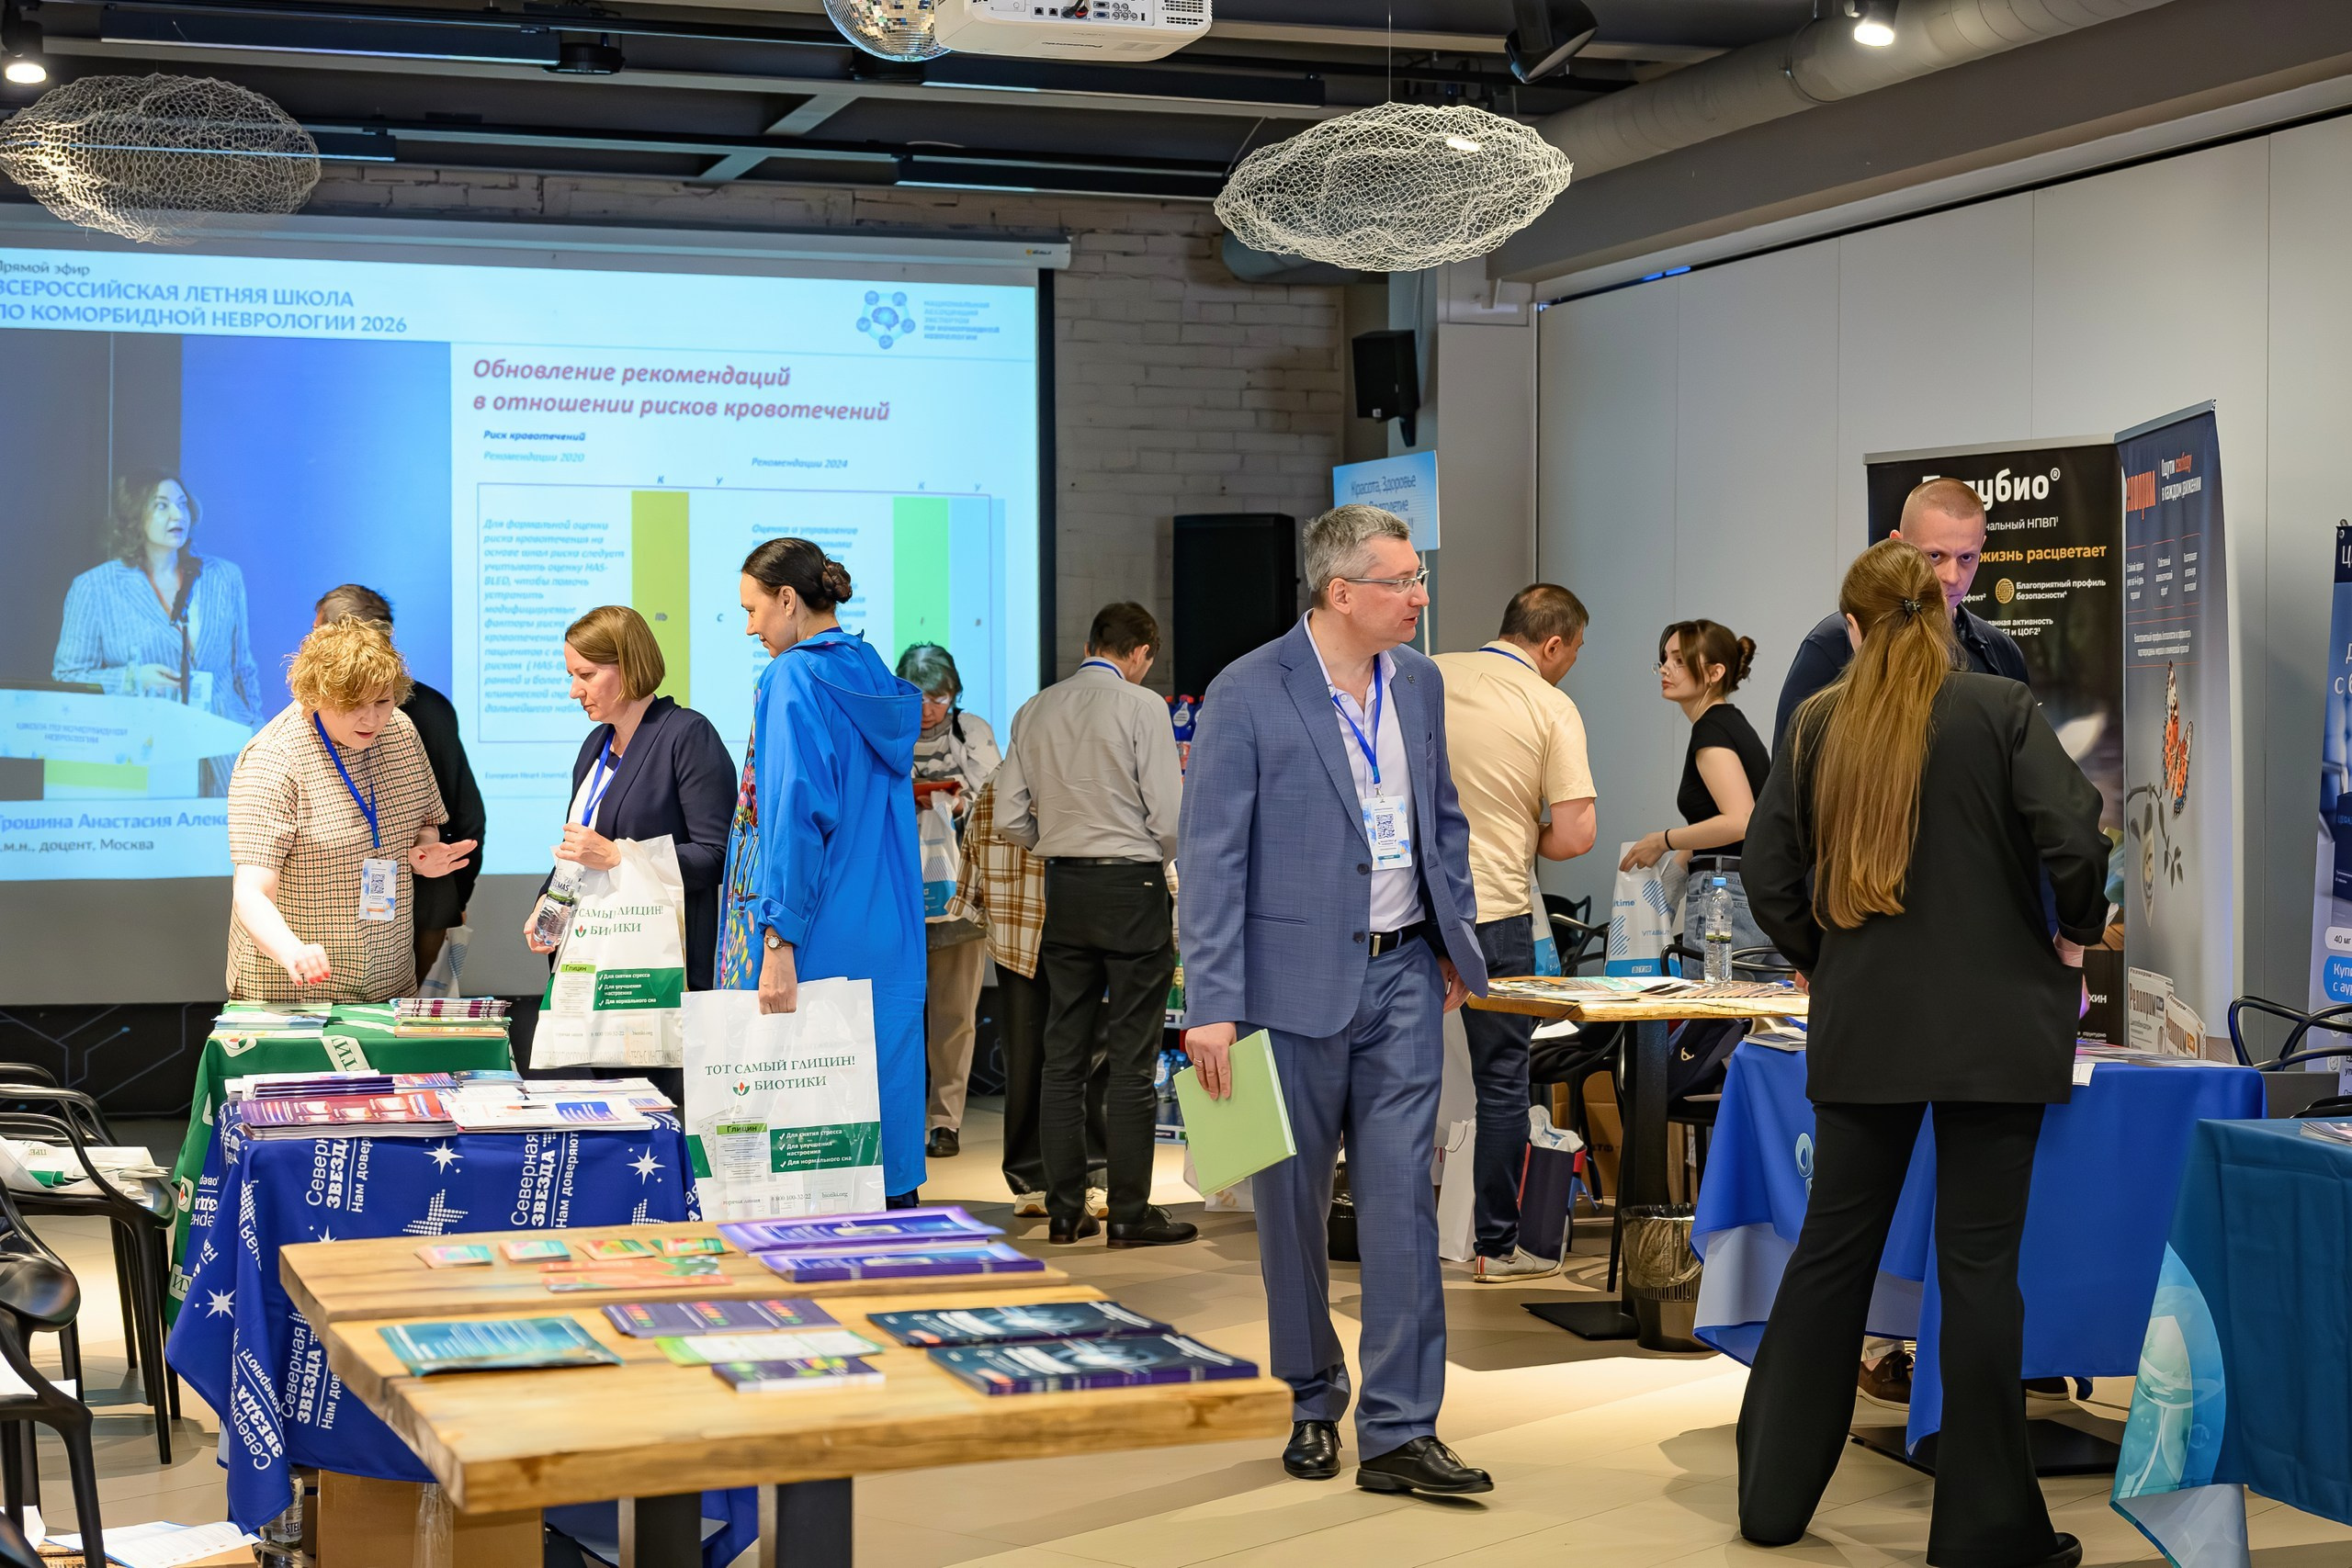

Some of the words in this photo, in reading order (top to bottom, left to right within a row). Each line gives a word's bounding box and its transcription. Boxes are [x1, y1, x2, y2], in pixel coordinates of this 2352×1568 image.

[54, 263, 90, 276] эфир
[184, 285, 267, 304] ЛЕТНЯЯ
[274, 288, 354, 308] ШКОЛА
[31, 305, 206, 327] КОМОРБИДНОЙ
[212, 310, 356, 331] НЕВРОЛОГИИ
[361, 315, 407, 333] 2026
[473, 359, 616, 382] Обновление
[622, 365, 790, 389] рекомендаций
[473, 395, 487, 411] в
[492, 396, 635, 413] отношении
[640, 398, 718, 418] рисков
[724, 400, 889, 422] кровотечений
[483, 429, 507, 442] Риск
[509, 430, 586, 443] кровотечений
[752, 457, 823, 470] Рекомендации
[2027, 546, 2107, 564] расцветает
[2016, 580, 2071, 590] Благоприятный
[2073, 579, 2106, 589] профиль
[78, 813, 172, 829] Анастасия
[39, 840, 96, 853] доцент,
[100, 838, 154, 850] Москва
[2334, 935, 2342, 943] 40
[705, 1064, 731, 1076] ТОТ
[734, 1059, 787, 1074] САМЫЙ
[791, 1055, 855, 1070] ГЛИЦИН!
[754, 1076, 826, 1090] БИОТИКИ
[727, 1125, 757, 1134] Глицин
[356, 1137, 373, 1180] довер
[800, 1156, 841, 1165] нормального
[511, 1134, 539, 1225] Северная
[531, 1150, 556, 1227] ЗВЕЗДА
[351, 1183, 365, 1213] Нам
[555, 1200, 570, 1228] Нам
[240, 1348, 280, 1414] доверяют!
[281, 1326, 307, 1417] Северная
[297, 1349, 322, 1424] ЗВЕЗДА
[237, 1384, 283, 1458] ЗВЕЗДА
[321, 1401, 336, 1429] Нам
